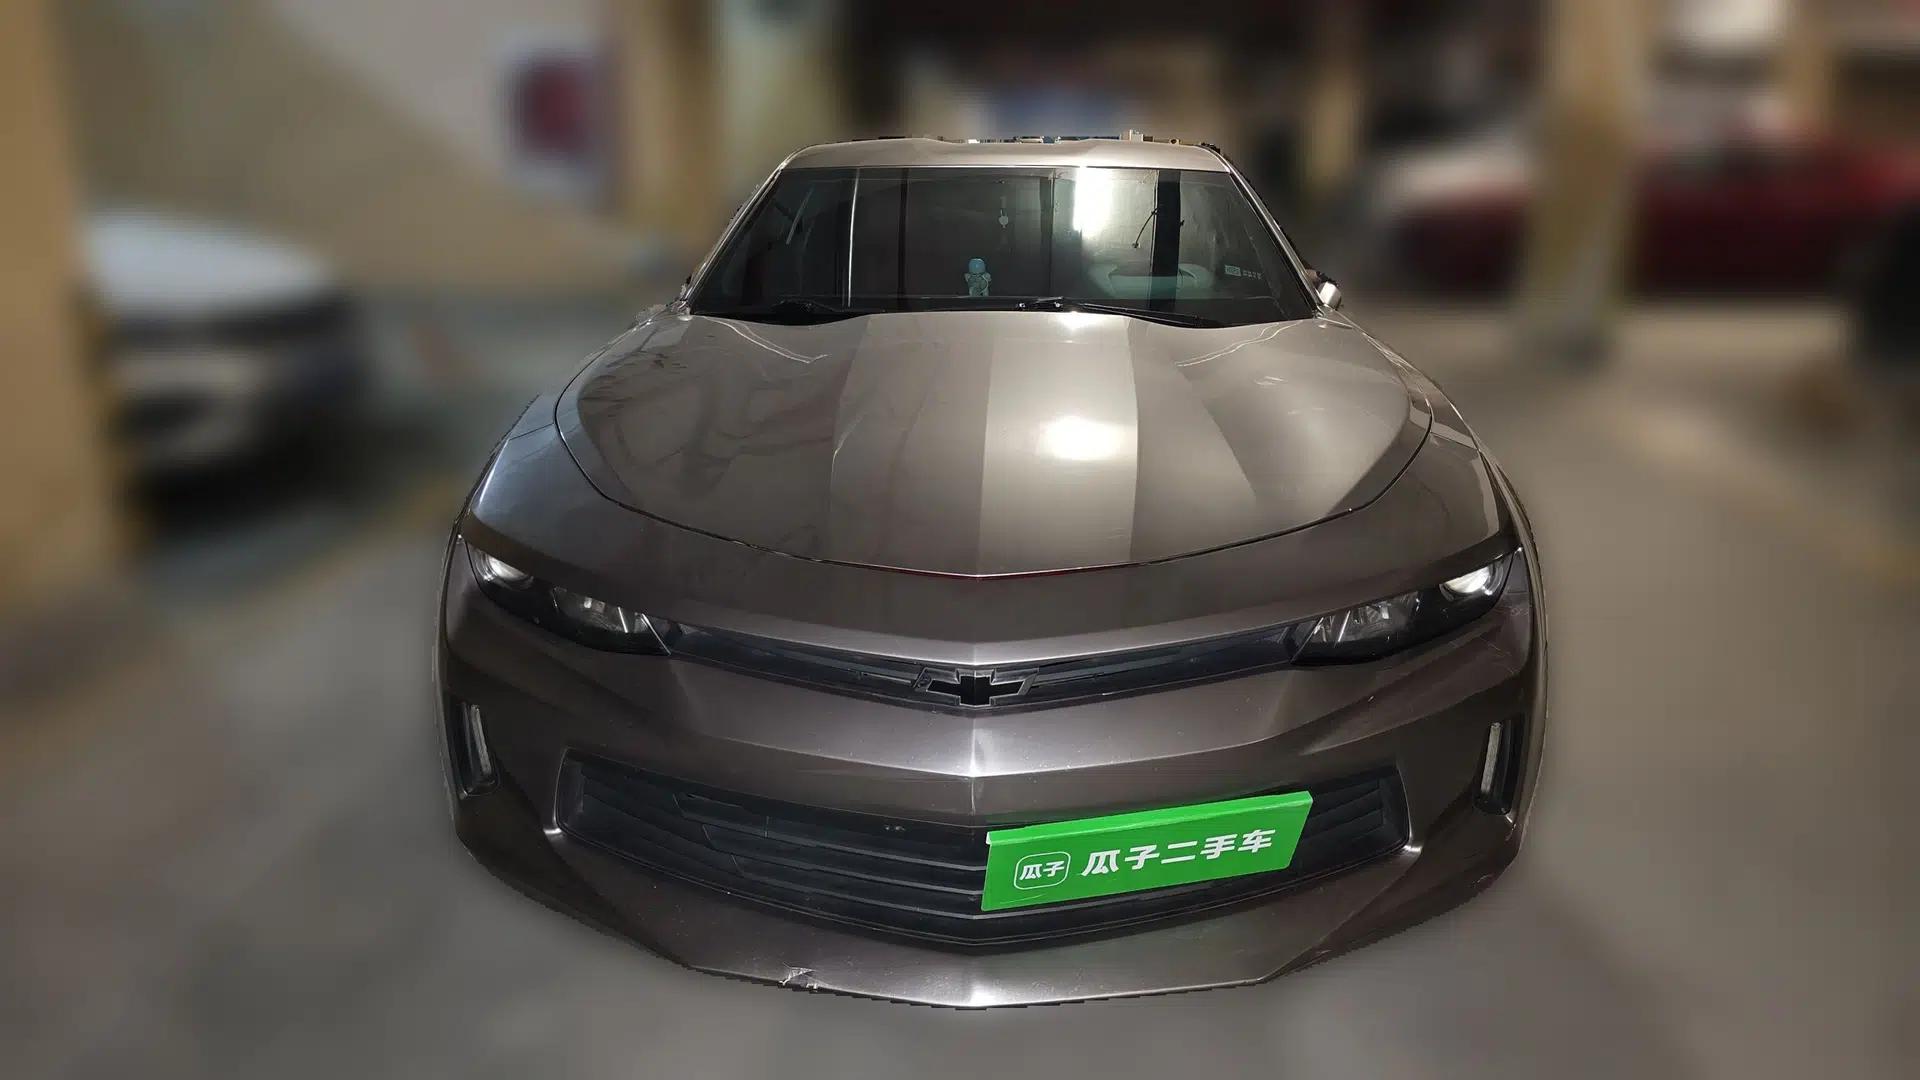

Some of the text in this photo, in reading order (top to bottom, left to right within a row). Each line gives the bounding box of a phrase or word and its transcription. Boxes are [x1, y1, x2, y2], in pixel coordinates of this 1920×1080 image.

[1019, 829, 1276, 880] 瓜子 瓜子二手车
